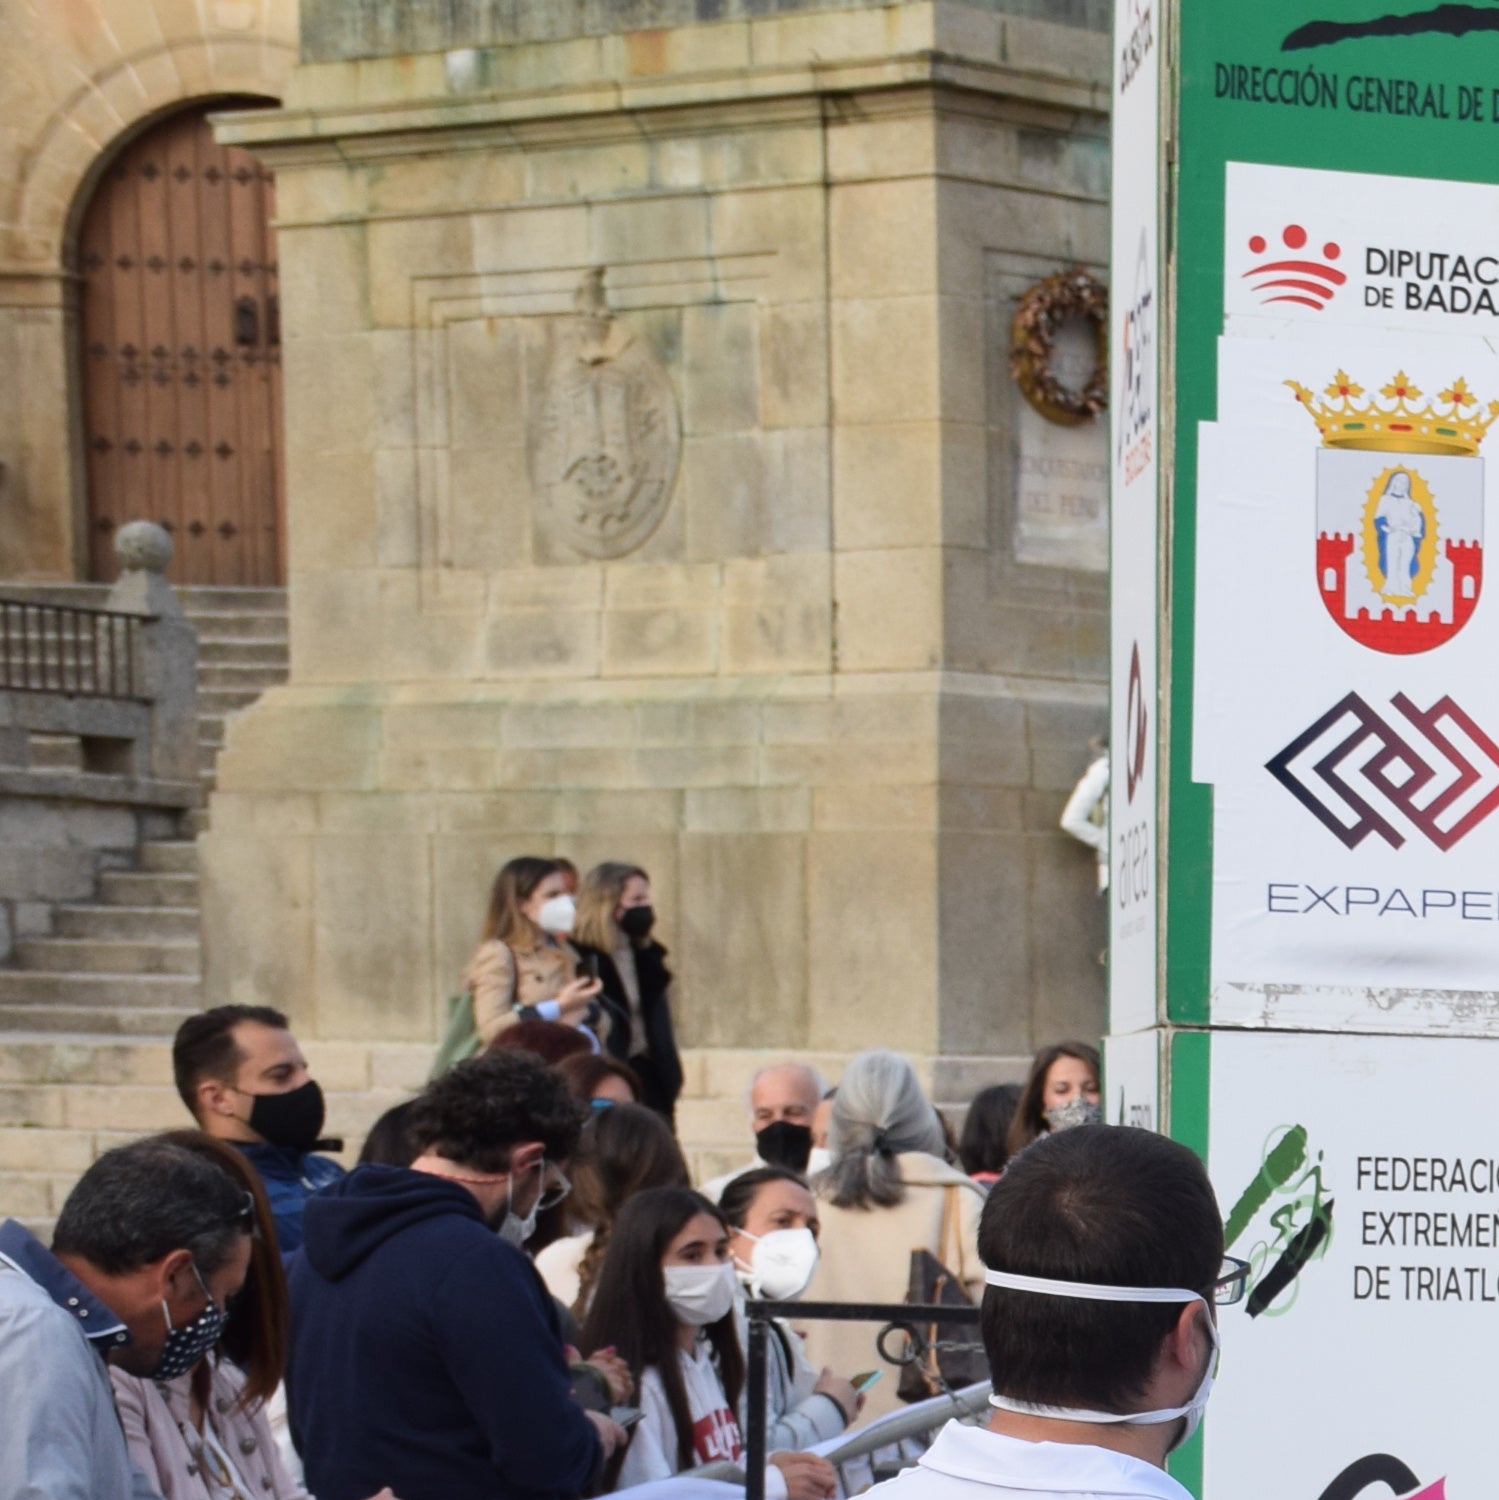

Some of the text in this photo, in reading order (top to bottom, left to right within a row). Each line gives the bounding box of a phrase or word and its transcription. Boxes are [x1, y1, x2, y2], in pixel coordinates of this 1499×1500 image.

[1214, 61, 1338, 109] DIRECCIÓN
[1346, 75, 1450, 119] GENERAL
[1458, 85, 1484, 122] DE
[1364, 285, 1394, 308] DE
[1354, 1265, 1391, 1301] DE
